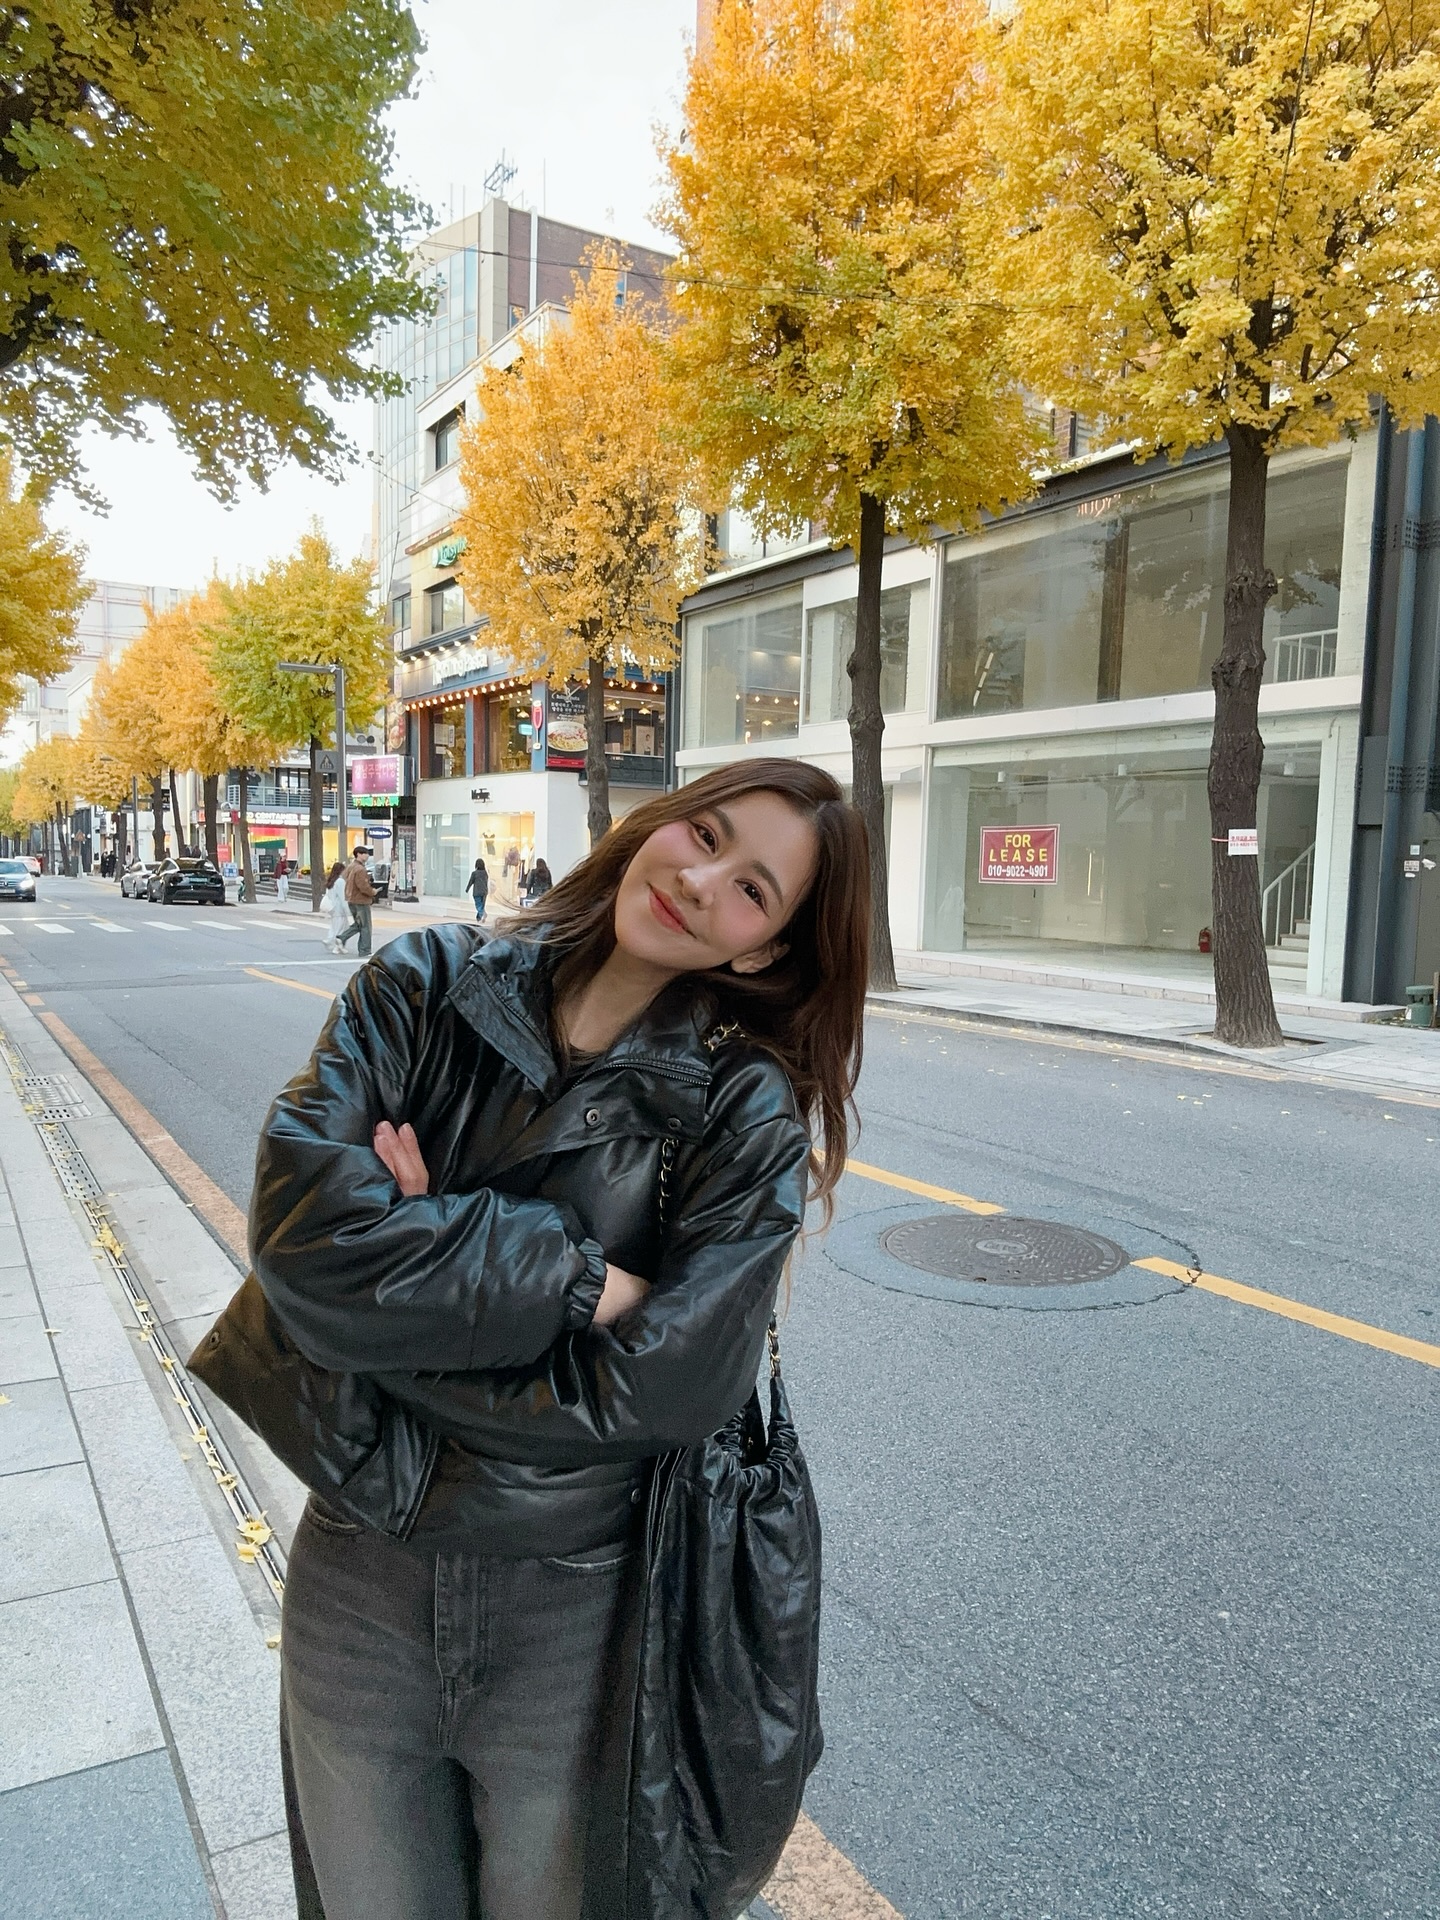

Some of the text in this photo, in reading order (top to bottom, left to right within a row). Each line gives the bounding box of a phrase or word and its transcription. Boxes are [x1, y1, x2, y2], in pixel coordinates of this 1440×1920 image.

[1005, 834, 1031, 847] FOR
[989, 849, 1047, 862] LEASE
[988, 864, 1048, 877] 010-9022-4901
